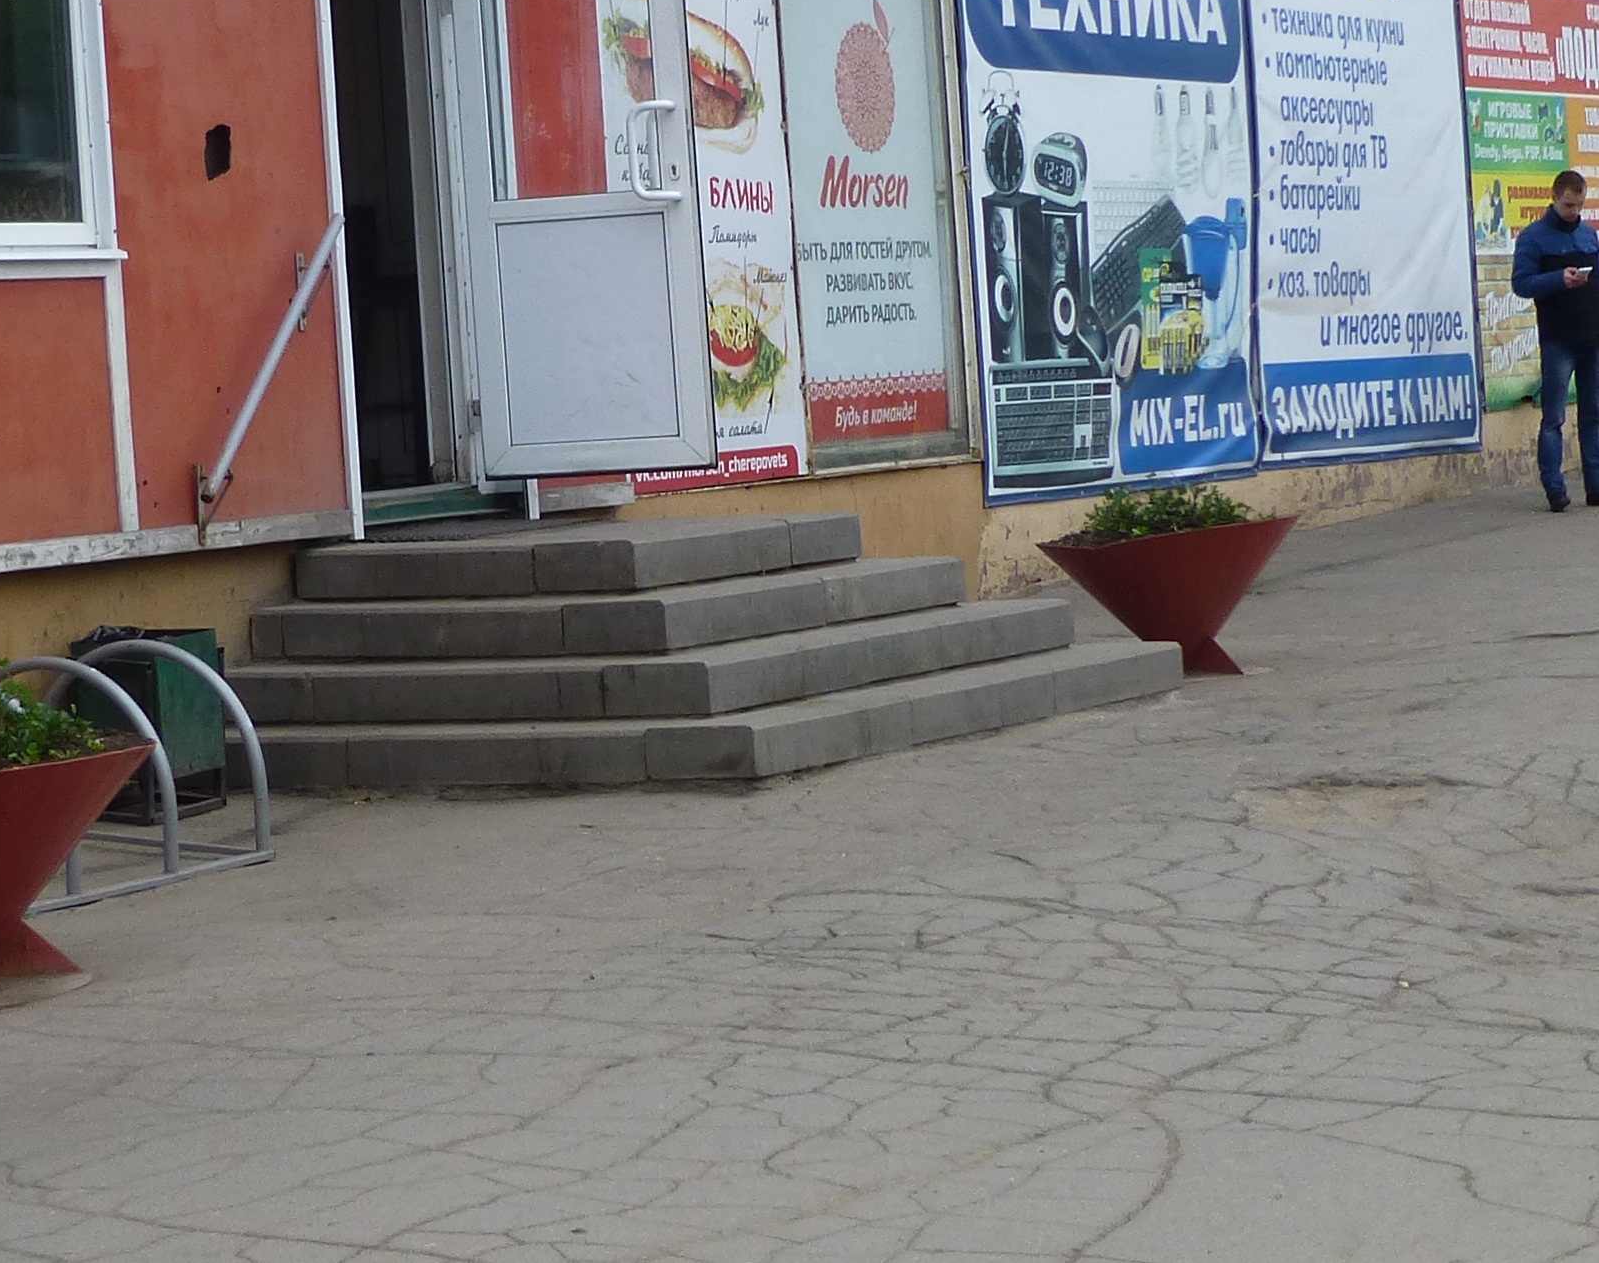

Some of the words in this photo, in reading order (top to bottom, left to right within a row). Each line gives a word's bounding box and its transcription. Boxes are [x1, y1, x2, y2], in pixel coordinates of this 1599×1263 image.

[1271, 7, 1334, 38] техника
[1337, 15, 1362, 49] для
[1365, 18, 1405, 52] кухни
[1276, 52, 1388, 92] компьютерные
[1280, 95, 1374, 134] аксессуары
[1488, 101, 1532, 120] ИГРОВЫЕ
[1280, 130, 1339, 175] товары
[1342, 142, 1367, 177] для
[1370, 134, 1389, 169] ТВ
[820, 155, 909, 209] Morsen
[1044, 161, 1073, 187] 12:38
[709, 175, 773, 215] БЛИНЫ
[1280, 174, 1361, 219] батарейки
[830, 241, 854, 263] ДЛЯ
[855, 237, 893, 260] ГОСТЕЙ
[1280, 226, 1321, 254] часы
[826, 272, 887, 292] РАЗВИВАТЬ
[888, 271, 914, 289] ВКУС.
[1277, 271, 1309, 298] хоз.
[1313, 261, 1371, 305] товары
[826, 305, 870, 327] ДАРИТЬ
[871, 302, 917, 325] РАДОСТЬ.
[1320, 316, 1331, 347] и
[1336, 313, 1401, 346] многое
[1406, 310, 1469, 354] другое.
[835, 403, 861, 433] Будь
[862, 410, 869, 425] в
[871, 400, 917, 425] команде!
[1130, 395, 1247, 447] MIX-EL.ru
[1271, 379, 1397, 439] ЗАХОДИТЕ
[1399, 378, 1418, 425] К
[1418, 374, 1472, 423] НАМ!
